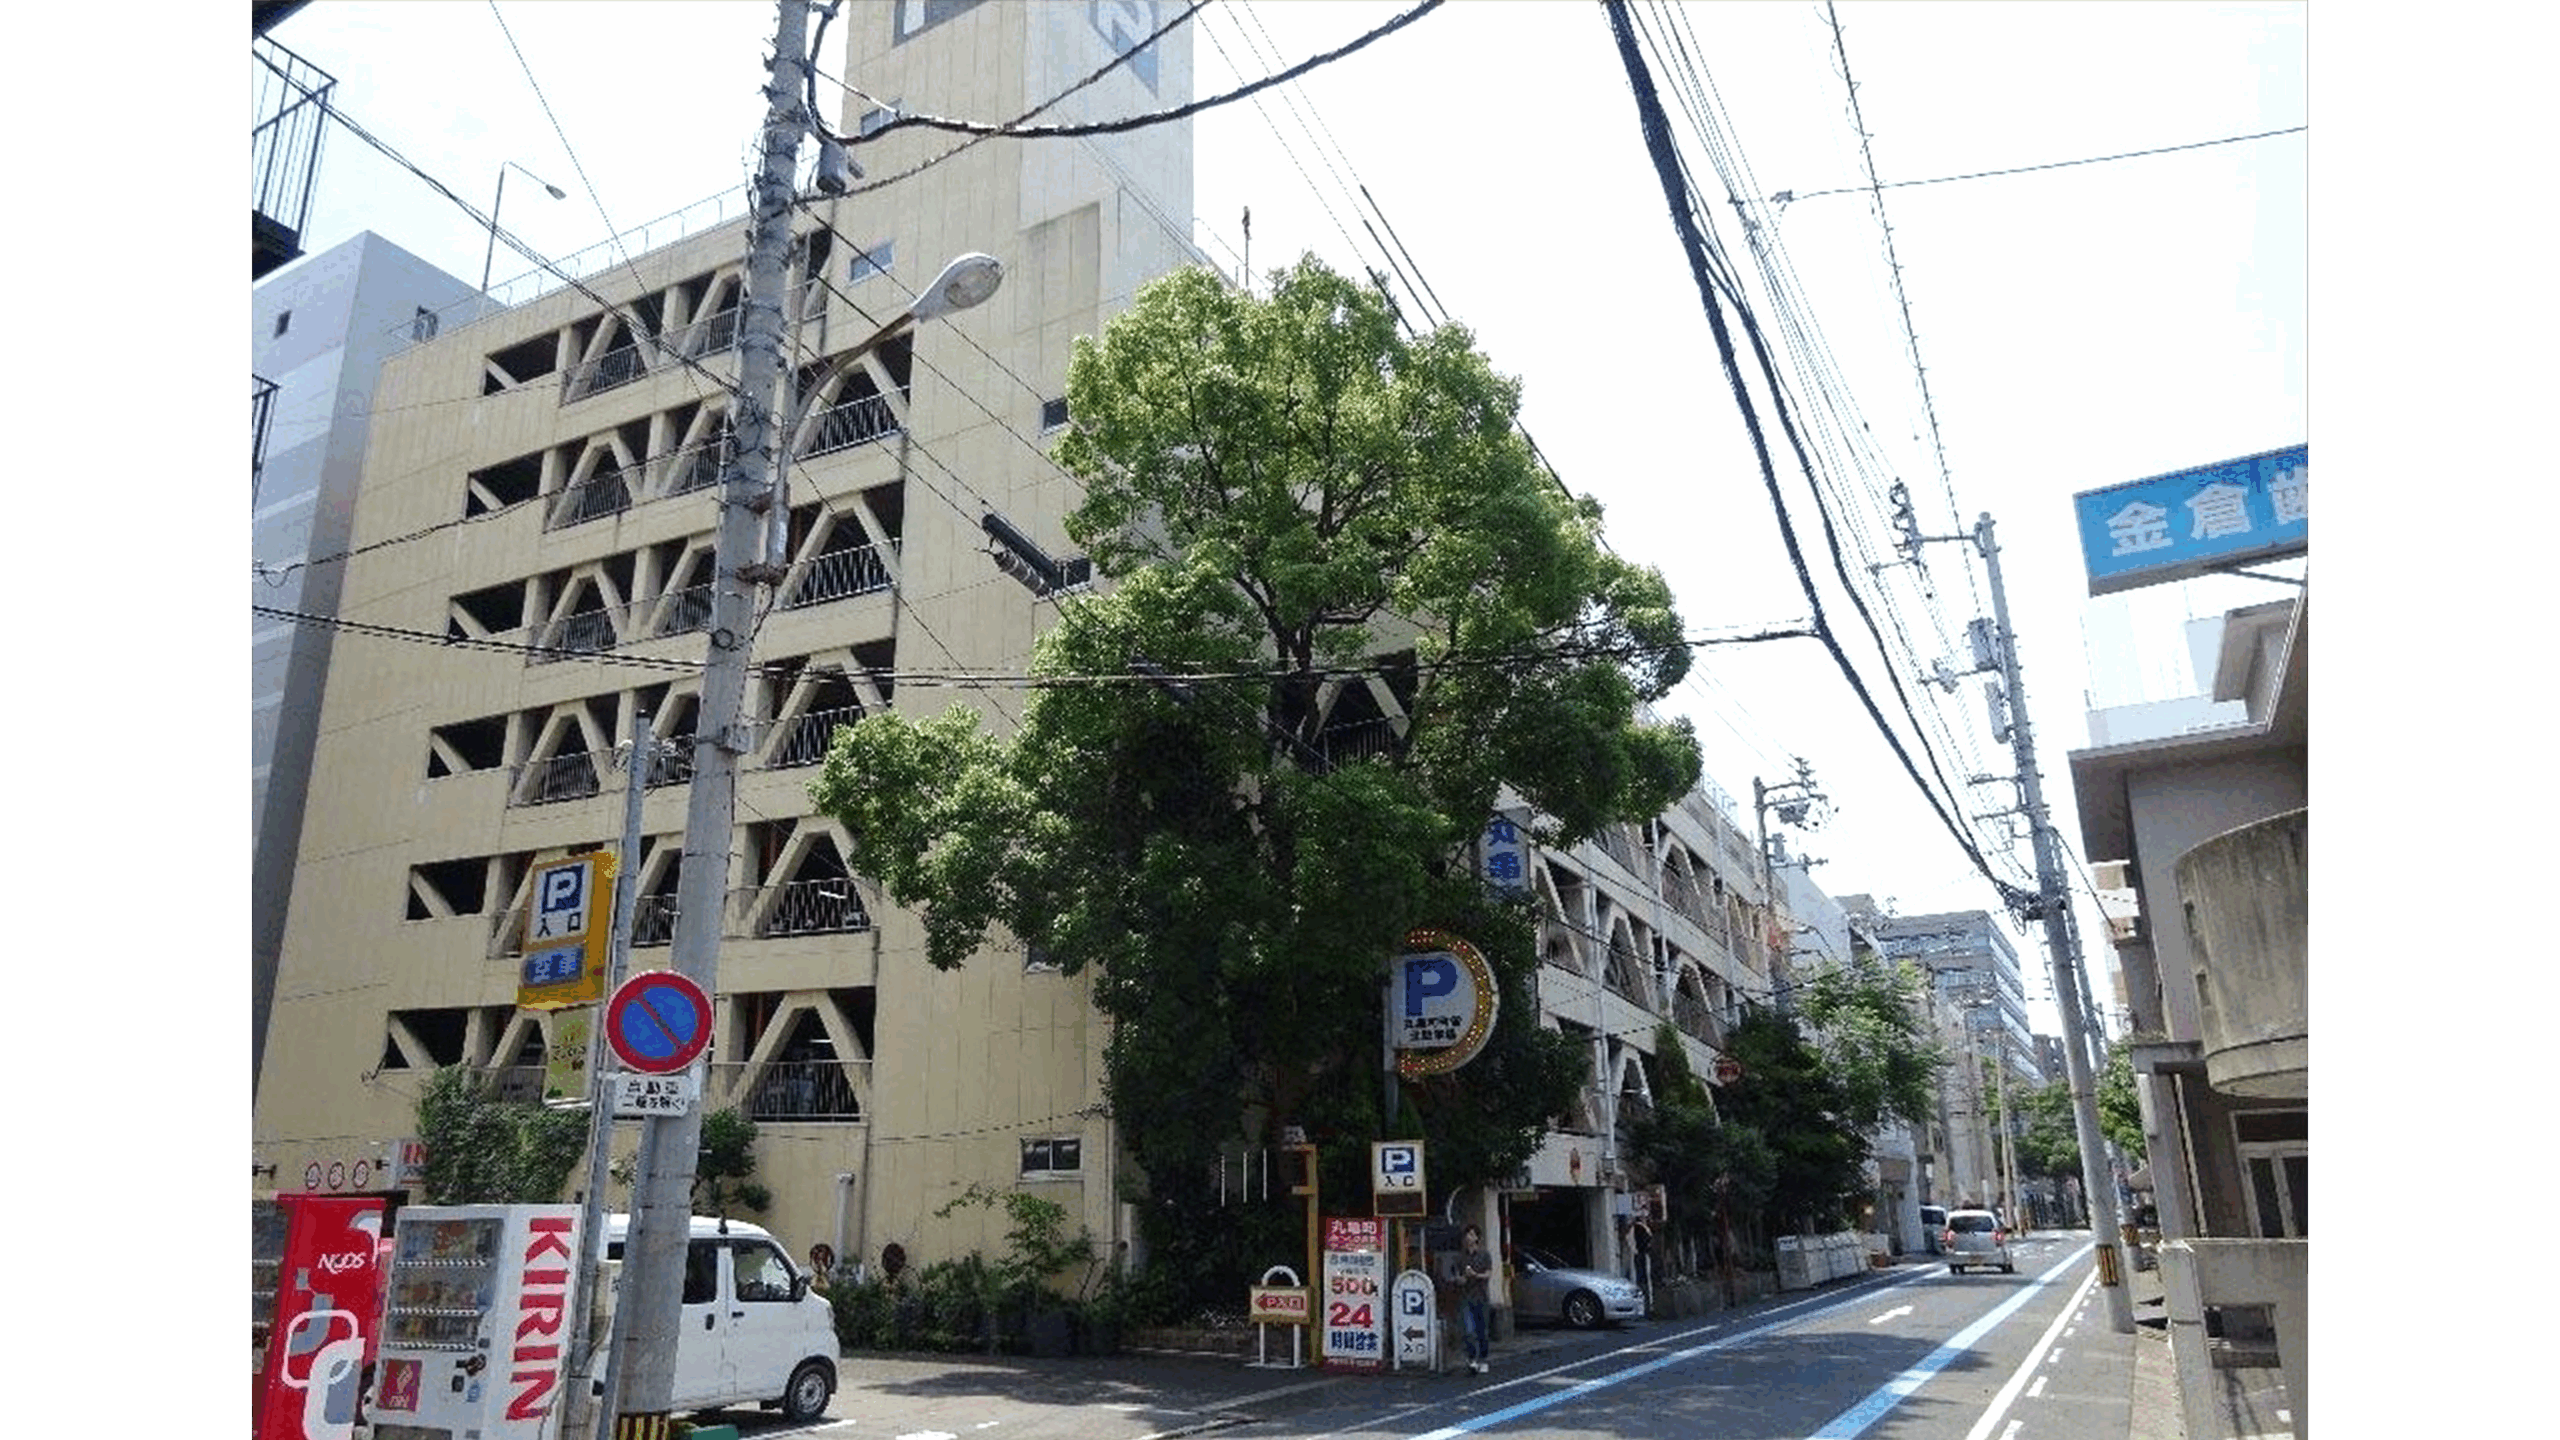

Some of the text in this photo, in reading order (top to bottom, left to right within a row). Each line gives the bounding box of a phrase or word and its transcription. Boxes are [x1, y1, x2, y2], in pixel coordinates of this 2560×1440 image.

[546, 870, 577, 909] P
[537, 911, 581, 937] 入口
[1405, 958, 1458, 1016] P
[1385, 1149, 1411, 1171] P
[1384, 1175, 1414, 1187] 入口
[1405, 1291, 1423, 1313] P
[505, 1217, 574, 1421] KIRIN
[1329, 1302, 1373, 1329] 24
